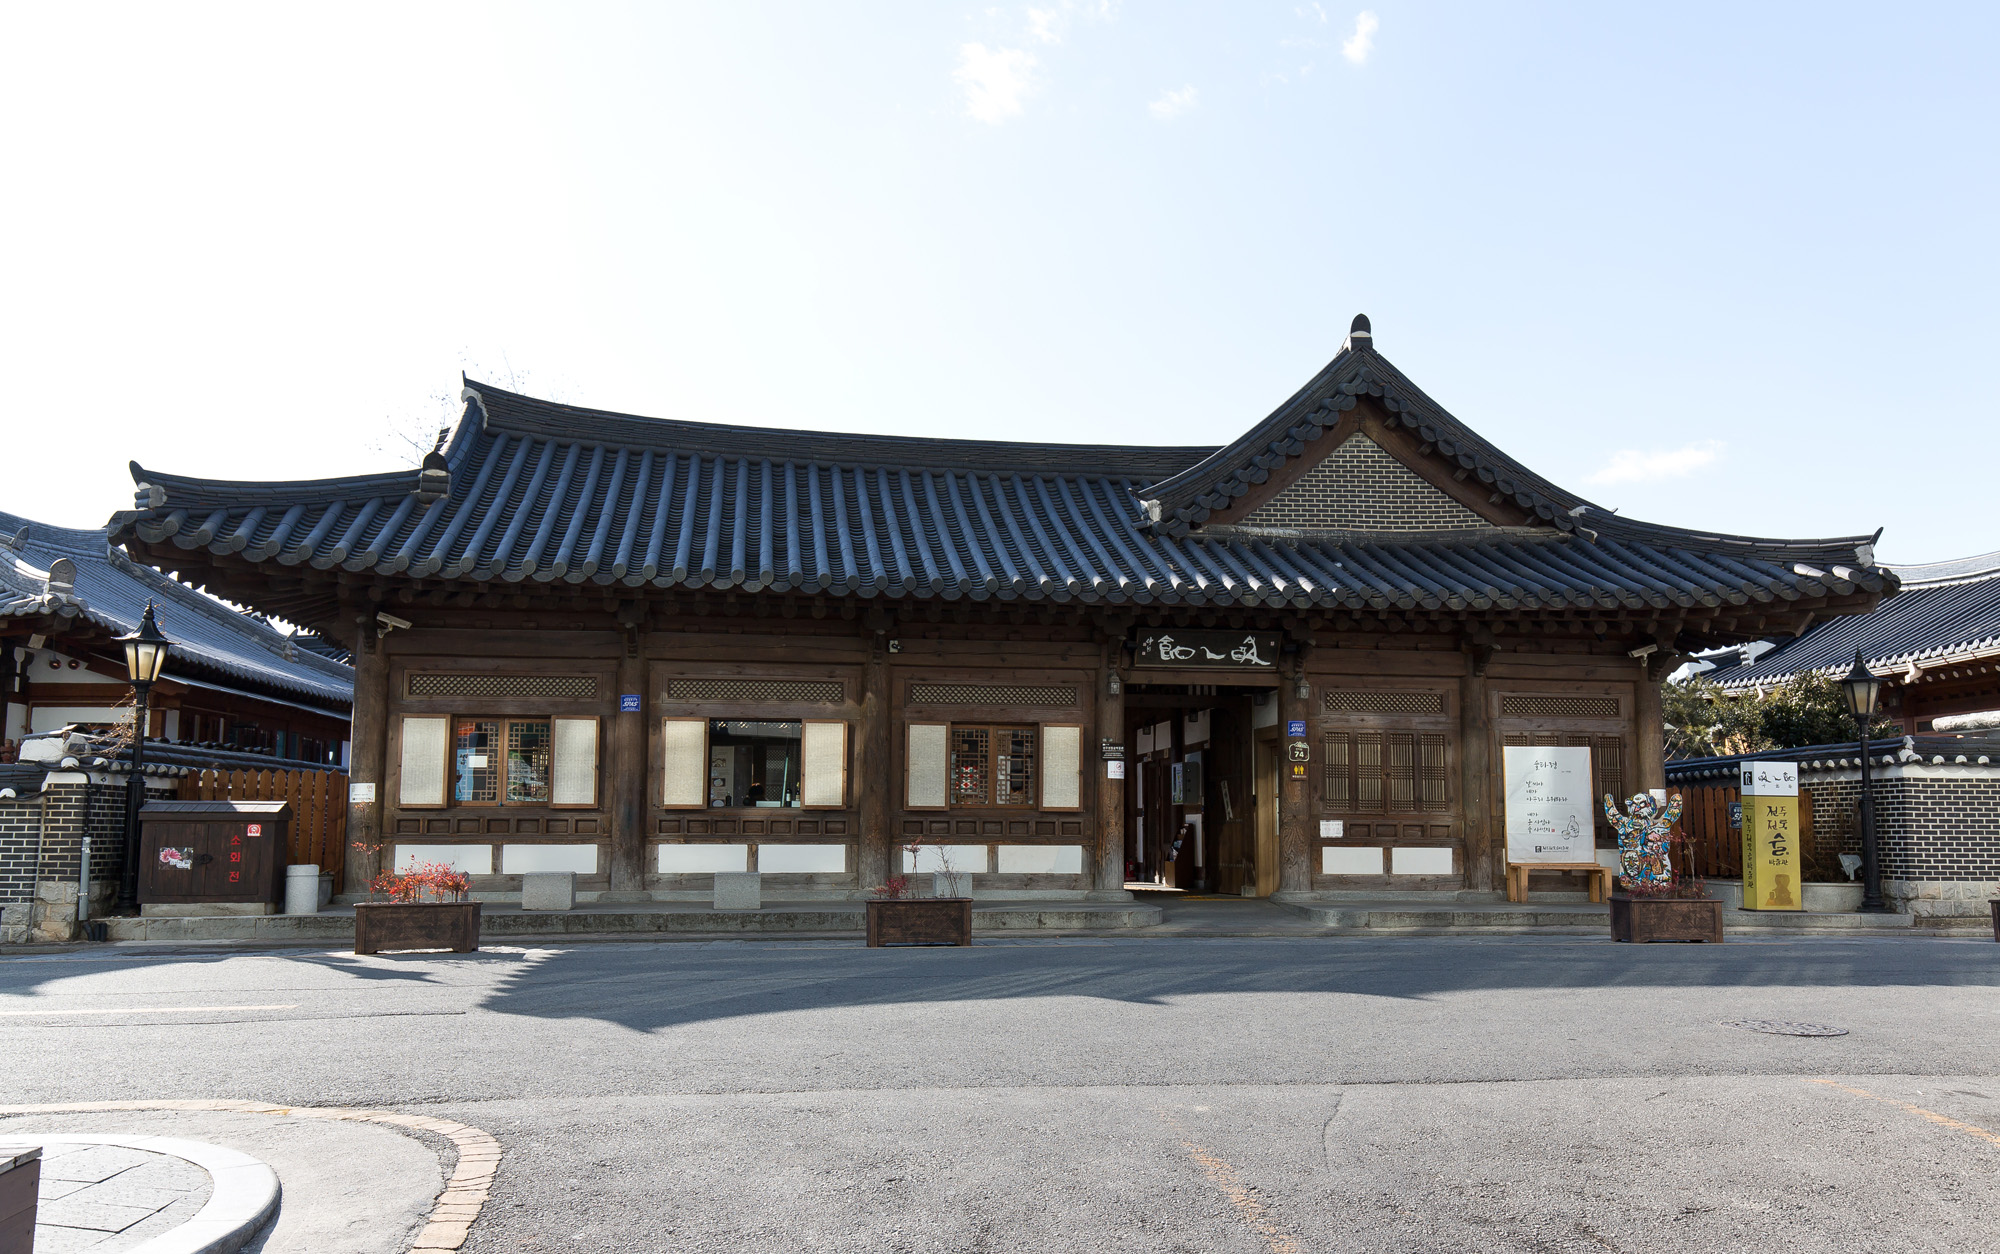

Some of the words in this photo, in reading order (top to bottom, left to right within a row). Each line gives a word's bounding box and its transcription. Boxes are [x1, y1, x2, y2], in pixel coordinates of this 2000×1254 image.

[1533, 760, 1558, 770] 술타령
[1766, 805, 1787, 817] 전주
[1767, 819, 1788, 830] 전통
[1768, 832, 1788, 857] 술
[229, 835, 241, 882] 소화전
[1768, 858, 1789, 866] 박물관
